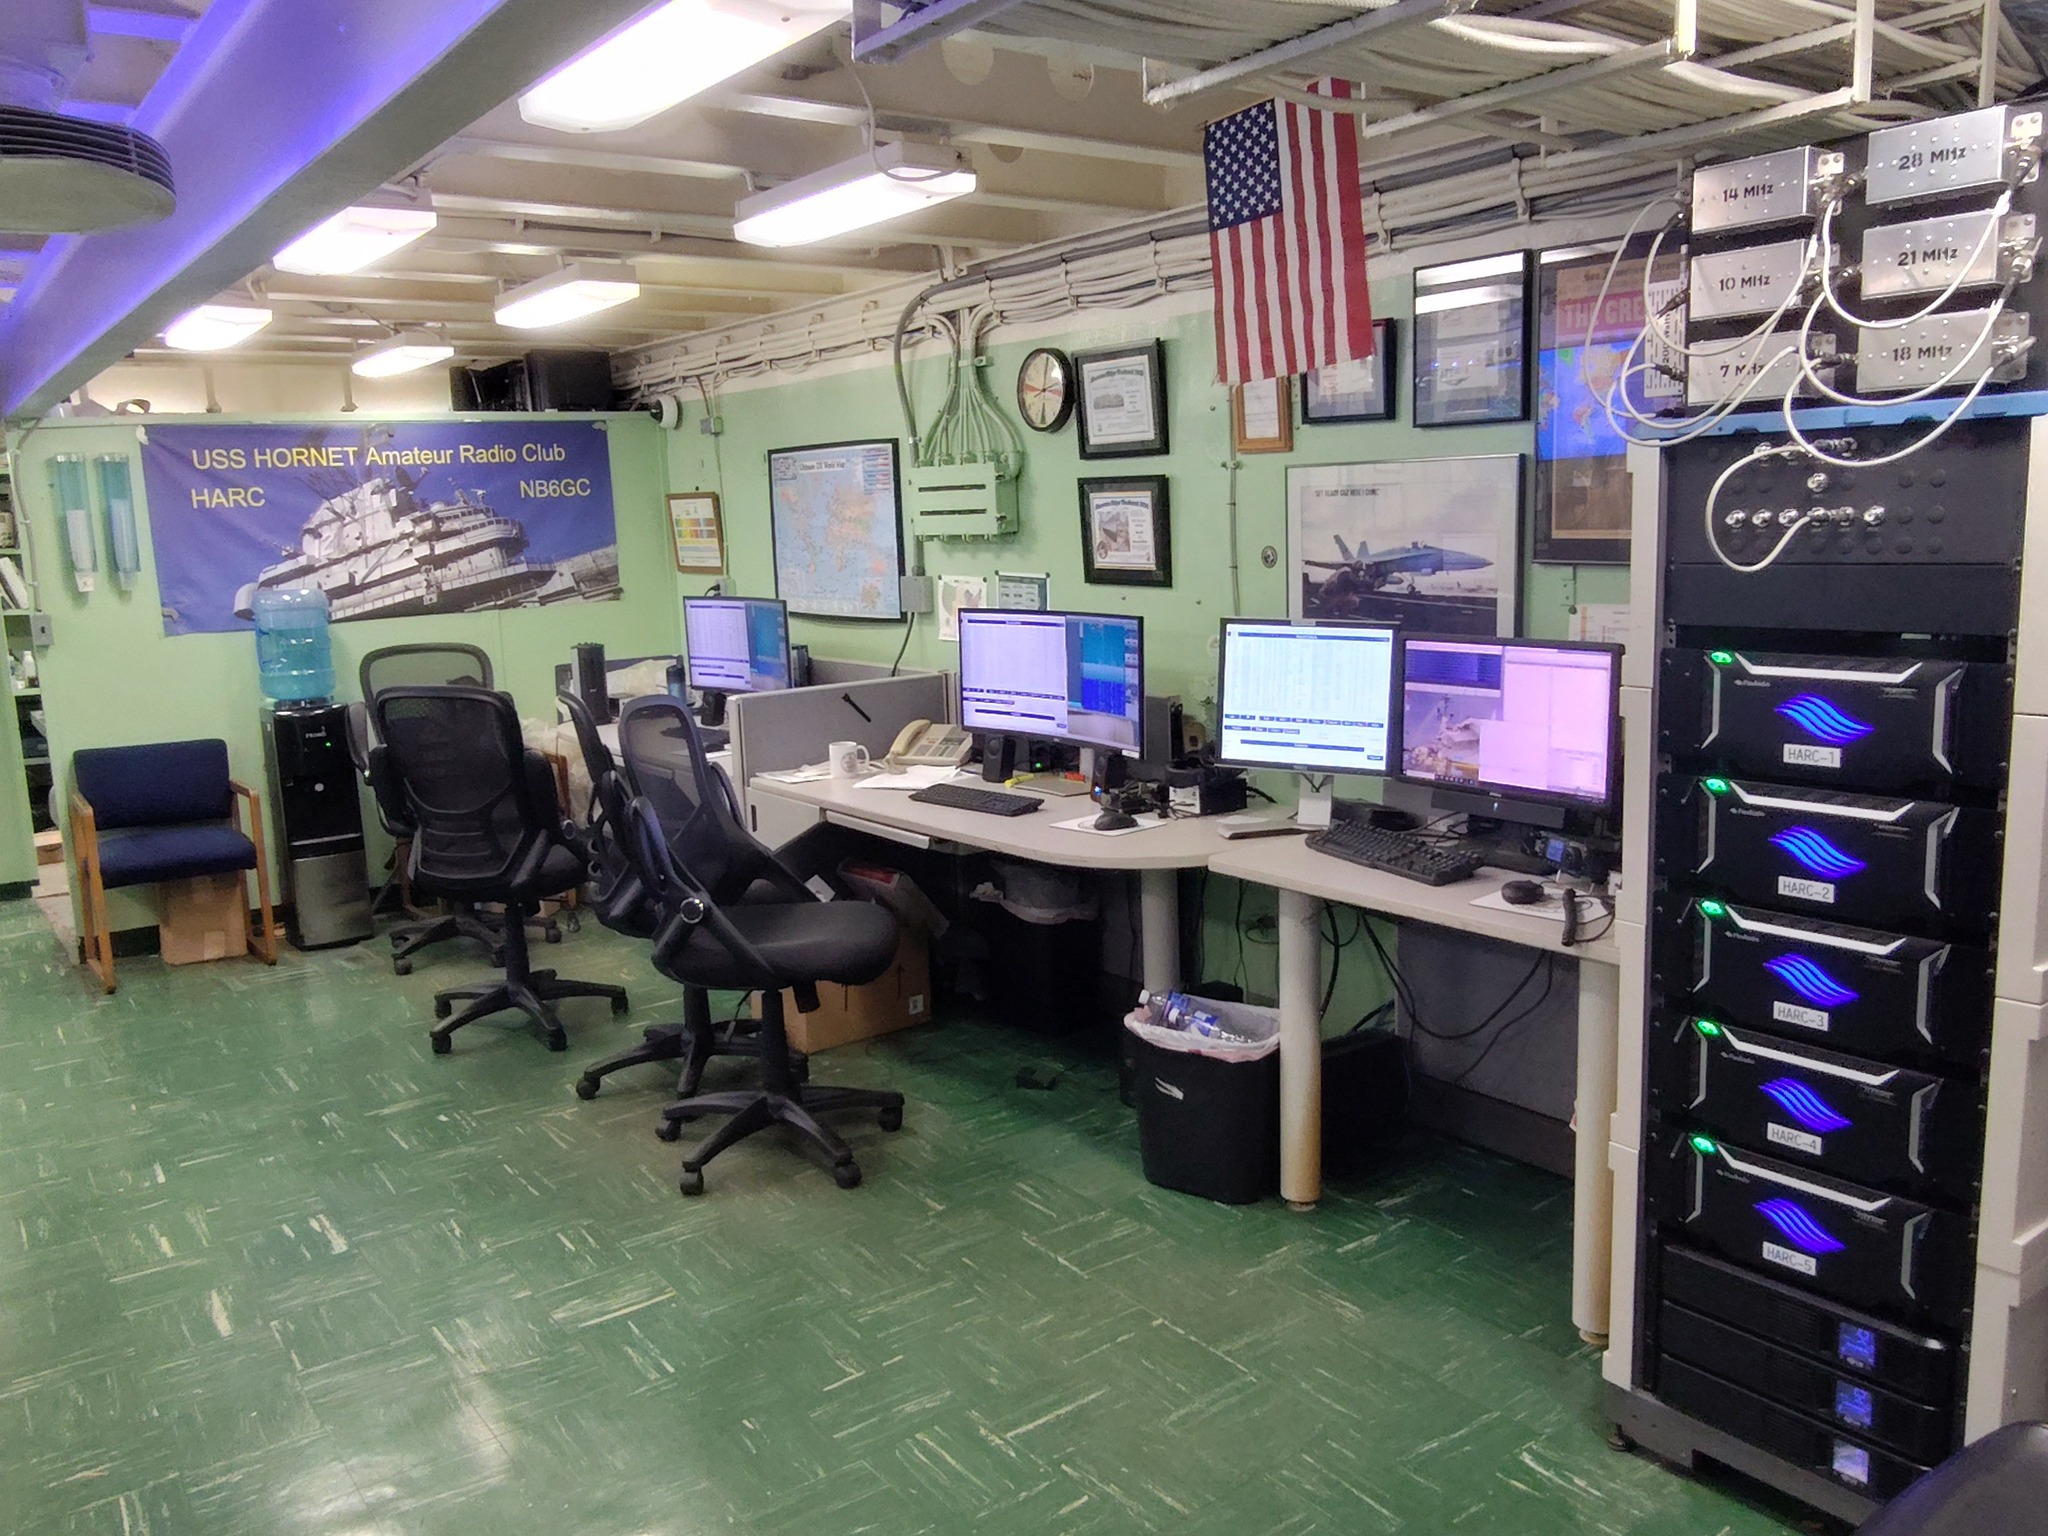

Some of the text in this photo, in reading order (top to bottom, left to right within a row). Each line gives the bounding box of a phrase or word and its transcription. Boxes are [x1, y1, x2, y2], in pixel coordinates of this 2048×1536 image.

[1898, 147, 1967, 170] 28 MHz
[1722, 183, 1774, 202] 14 MHz
[1897, 248, 1958, 266] 21 MHz
[1719, 275, 1771, 291] 10 MHz
[1892, 345, 1953, 362] 18 MHz
[1720, 364, 1730, 378] 7
[191, 443, 566, 470] USS HORNET Amateur Radio Club
[191, 486, 266, 509] HARC
[520, 478, 591, 498] NB6GC
[1788, 747, 1834, 764] HARC-1
[1783, 881, 1830, 900] HARC-2
[1777, 1005, 1825, 1027] HARC-3
[1771, 1127, 1817, 1150] HARC-4
[1766, 1244, 1813, 1271] HARC-5
